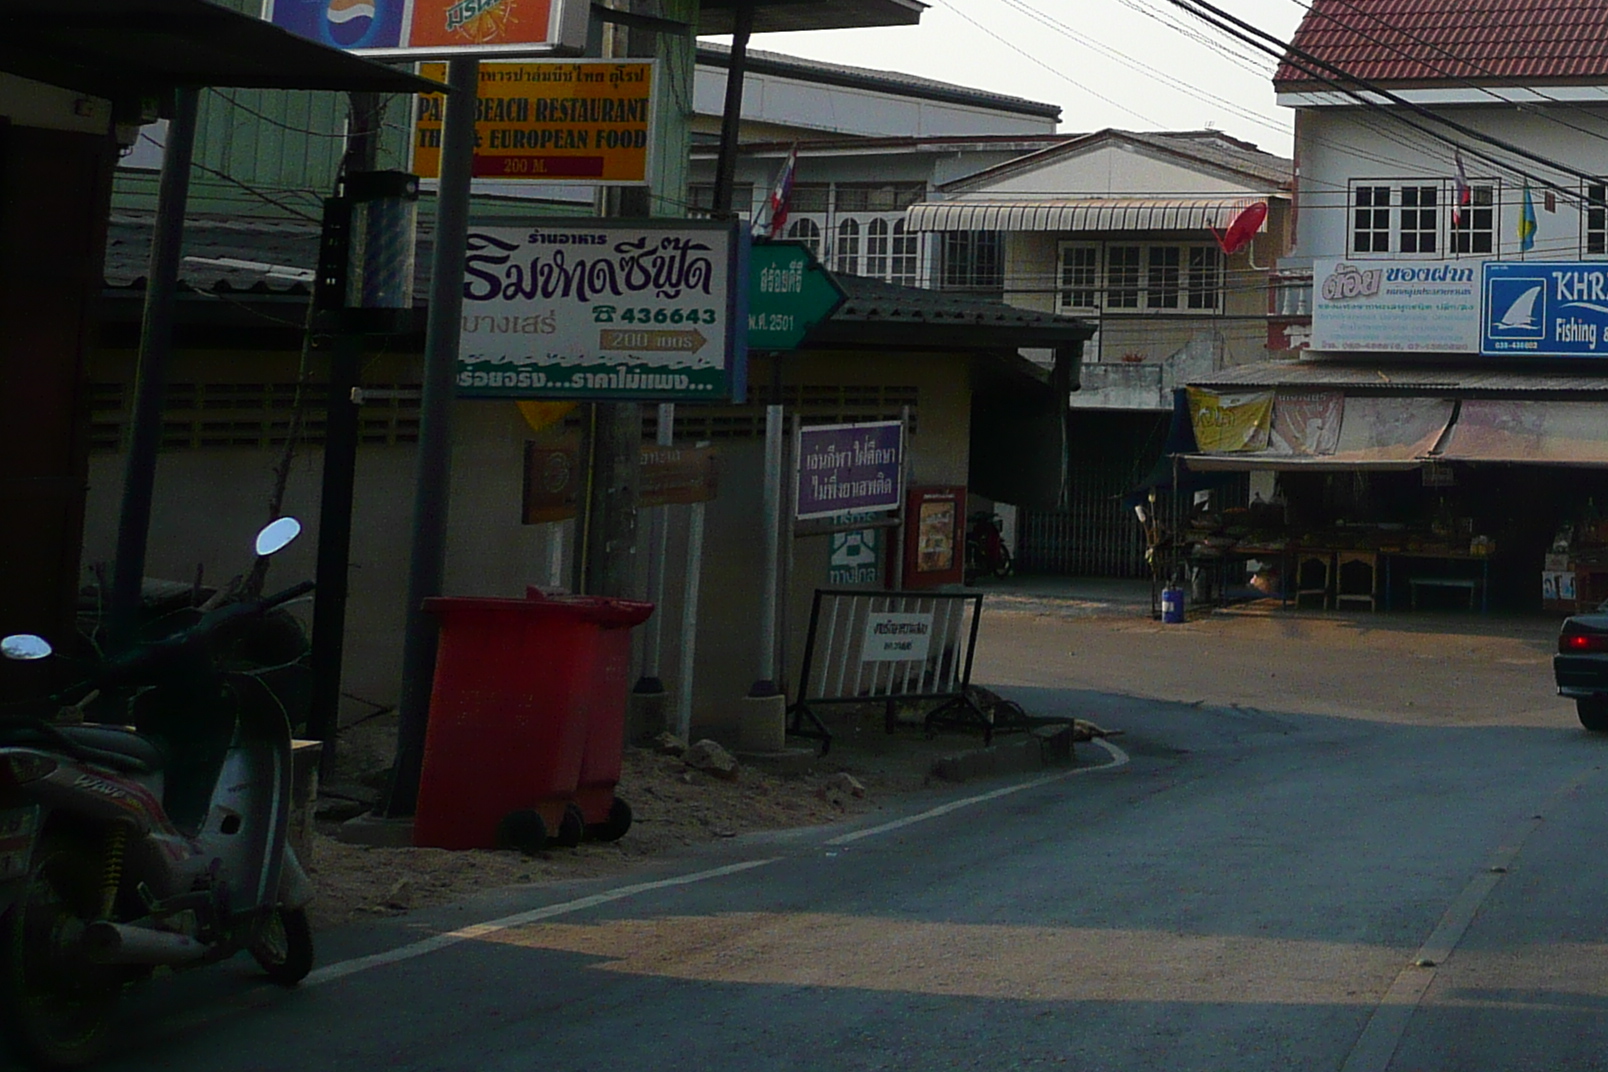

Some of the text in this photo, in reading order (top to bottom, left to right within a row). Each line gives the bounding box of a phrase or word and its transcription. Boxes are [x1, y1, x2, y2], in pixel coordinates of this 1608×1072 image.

[534, 97, 650, 123] RESTAURANT
[489, 128, 588, 150] EUROPEAN
[594, 129, 648, 150] FOOD
[503, 158, 528, 174] 200
[527, 229, 608, 246] ร้านอาหาร
[620, 307, 716, 325] 436643
[610, 331, 694, 349] 200 เมตร
[1555, 317, 1598, 350] Fishing
